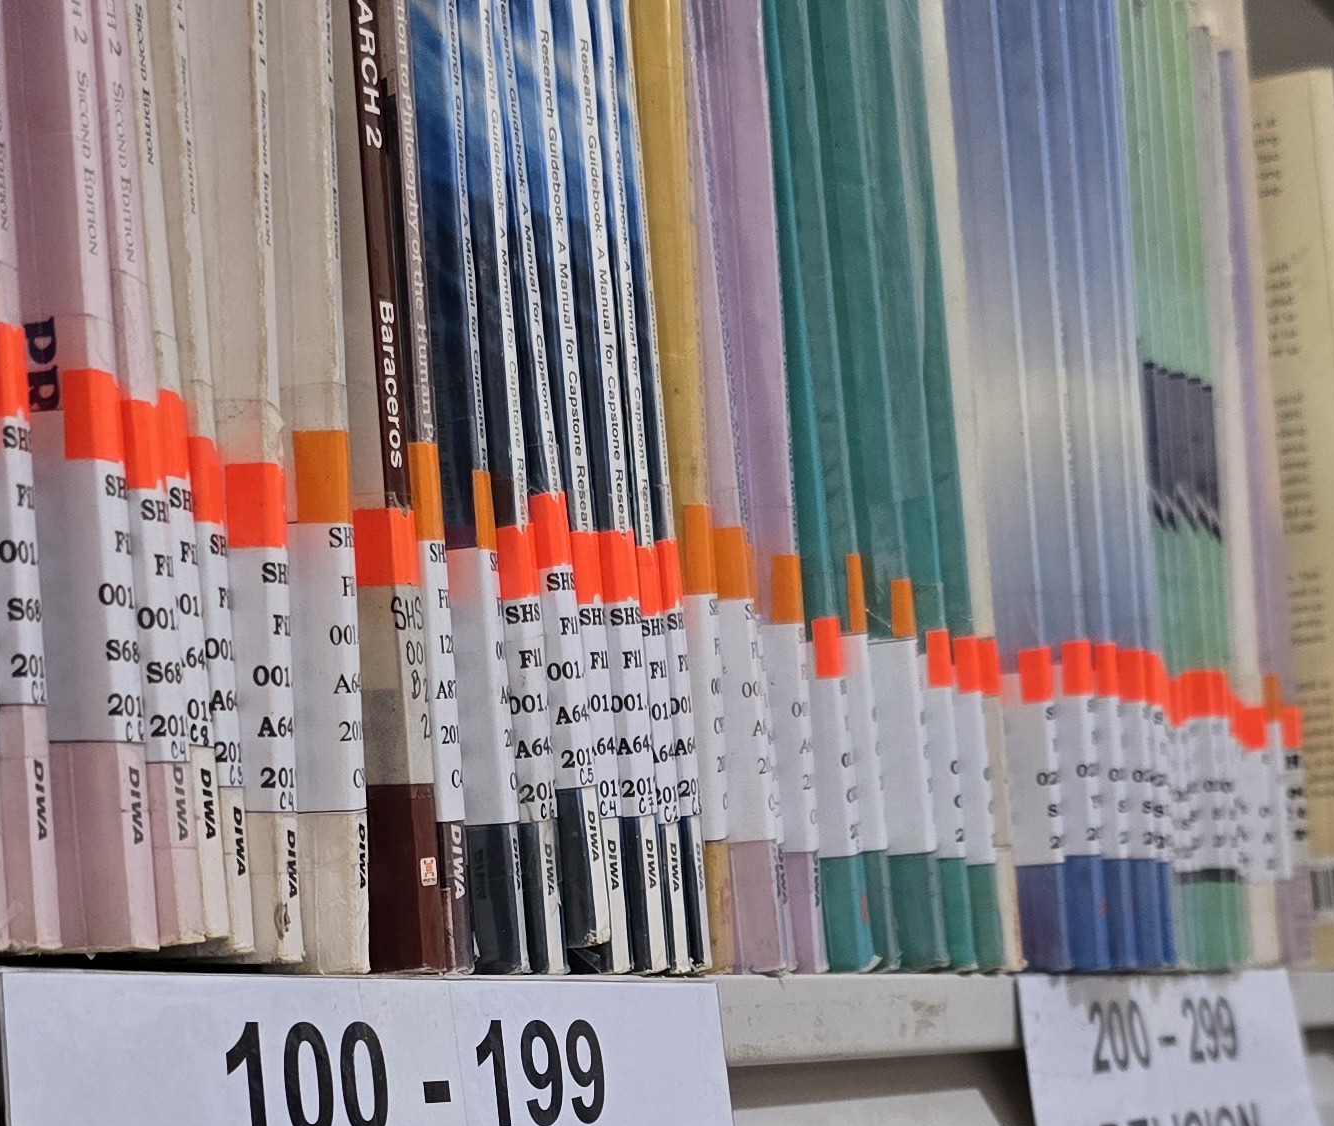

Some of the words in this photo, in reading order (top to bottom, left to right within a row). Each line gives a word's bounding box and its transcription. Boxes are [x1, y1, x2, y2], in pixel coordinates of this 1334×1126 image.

[500, 0, 514, 79] esearch
[135, 2, 148, 81] SECOND
[143, 88, 155, 166] EDITION
[400, 65, 409, 87] to
[540, 29, 555, 119] Research
[580, 38, 595, 127] Research
[74, 26, 88, 45] 2
[83, 166, 98, 256] EDITION
[109, 38, 122, 57] 2
[120, 175, 135, 263] EDITION
[366, 126, 383, 149] 2
[509, 88, 527, 197] Guidebook:
[402, 93, 419, 231] Philosophy
[548, 126, 566, 232] Guidebook:
[588, 135, 605, 239] Guidebook:
[483, 8, 497, 101] Research
[499, 226, 507, 239] A
[509, 360, 522, 449] Capstone
[522, 203, 530, 216] A
[411, 238, 423, 266] of
[524, 224, 538, 294] Manual
[557, 239, 567, 254] A
[597, 246, 606, 261] A
[624, 260, 632, 273] A
[413, 267, 424, 311] the
[559, 263, 572, 330] Manual
[599, 269, 613, 336] Manual
[470, 315, 478, 341] for
[532, 301, 541, 325] for
[625, 281, 638, 347] Manual
[417, 323, 431, 415] Human
[565, 338, 575, 363] for
[605, 344, 614, 369] for
[631, 355, 639, 378] for
[378, 301, 404, 469] Baraceros
[473, 350, 486, 439] Capstone
[535, 334, 551, 421] Capstone
[568, 370, 583, 457] Capstone
[607, 375, 622, 461] Capstone
[634, 386, 648, 471] Capstone
[2, 425, 31, 452] SH
[261, 562, 289, 585] SH
[546, 572, 575, 592] SHS
[7, 598, 42, 623] S68
[391, 596, 425, 630] SHS
[506, 603, 540, 625] SHS
[560, 616, 579, 635] Fil
[610, 607, 641, 626] SHS
[642, 618, 665, 637] SHS
[106, 639, 140, 664] S68
[182, 647, 206, 670] 64
[519, 648, 542, 669] Fil
[590, 651, 609, 669] Fil
[622, 649, 642, 669] Fil
[649, 660, 667, 679] Fil
[147, 662, 182, 684] S68
[588, 694, 609, 712] 01
[150, 715, 188, 737] 201
[257, 716, 294, 738] A64
[517, 737, 553, 759] A64
[593, 737, 616, 756] 64
[260, 767, 295, 789] 201
[519, 780, 556, 804] 201
[33, 759, 47, 841] DIWA
[129, 766, 144, 845] DIWA
[173, 764, 188, 842] DIWA
[200, 768, 216, 840] DIWA
[600, 800, 617, 817] C4
[664, 806, 678, 823] C2
[233, 806, 247, 876] DIWA
[588, 810, 600, 862] DIWA
[286, 830, 299, 898] DIWA
[357, 822, 367, 890] DIWA
[451, 824, 466, 900] DIWA
[544, 843, 555, 896] DIWA
[607, 839, 619, 890] DIWA
[645, 839, 657, 889] DIWA
[670, 843, 681, 892] DIWA
[695, 842, 704, 892] DIWA
[1088, 1000, 1151, 1075] 200
[1182, 995, 1239, 1064] 299
[423, 1080, 451, 1104] -
